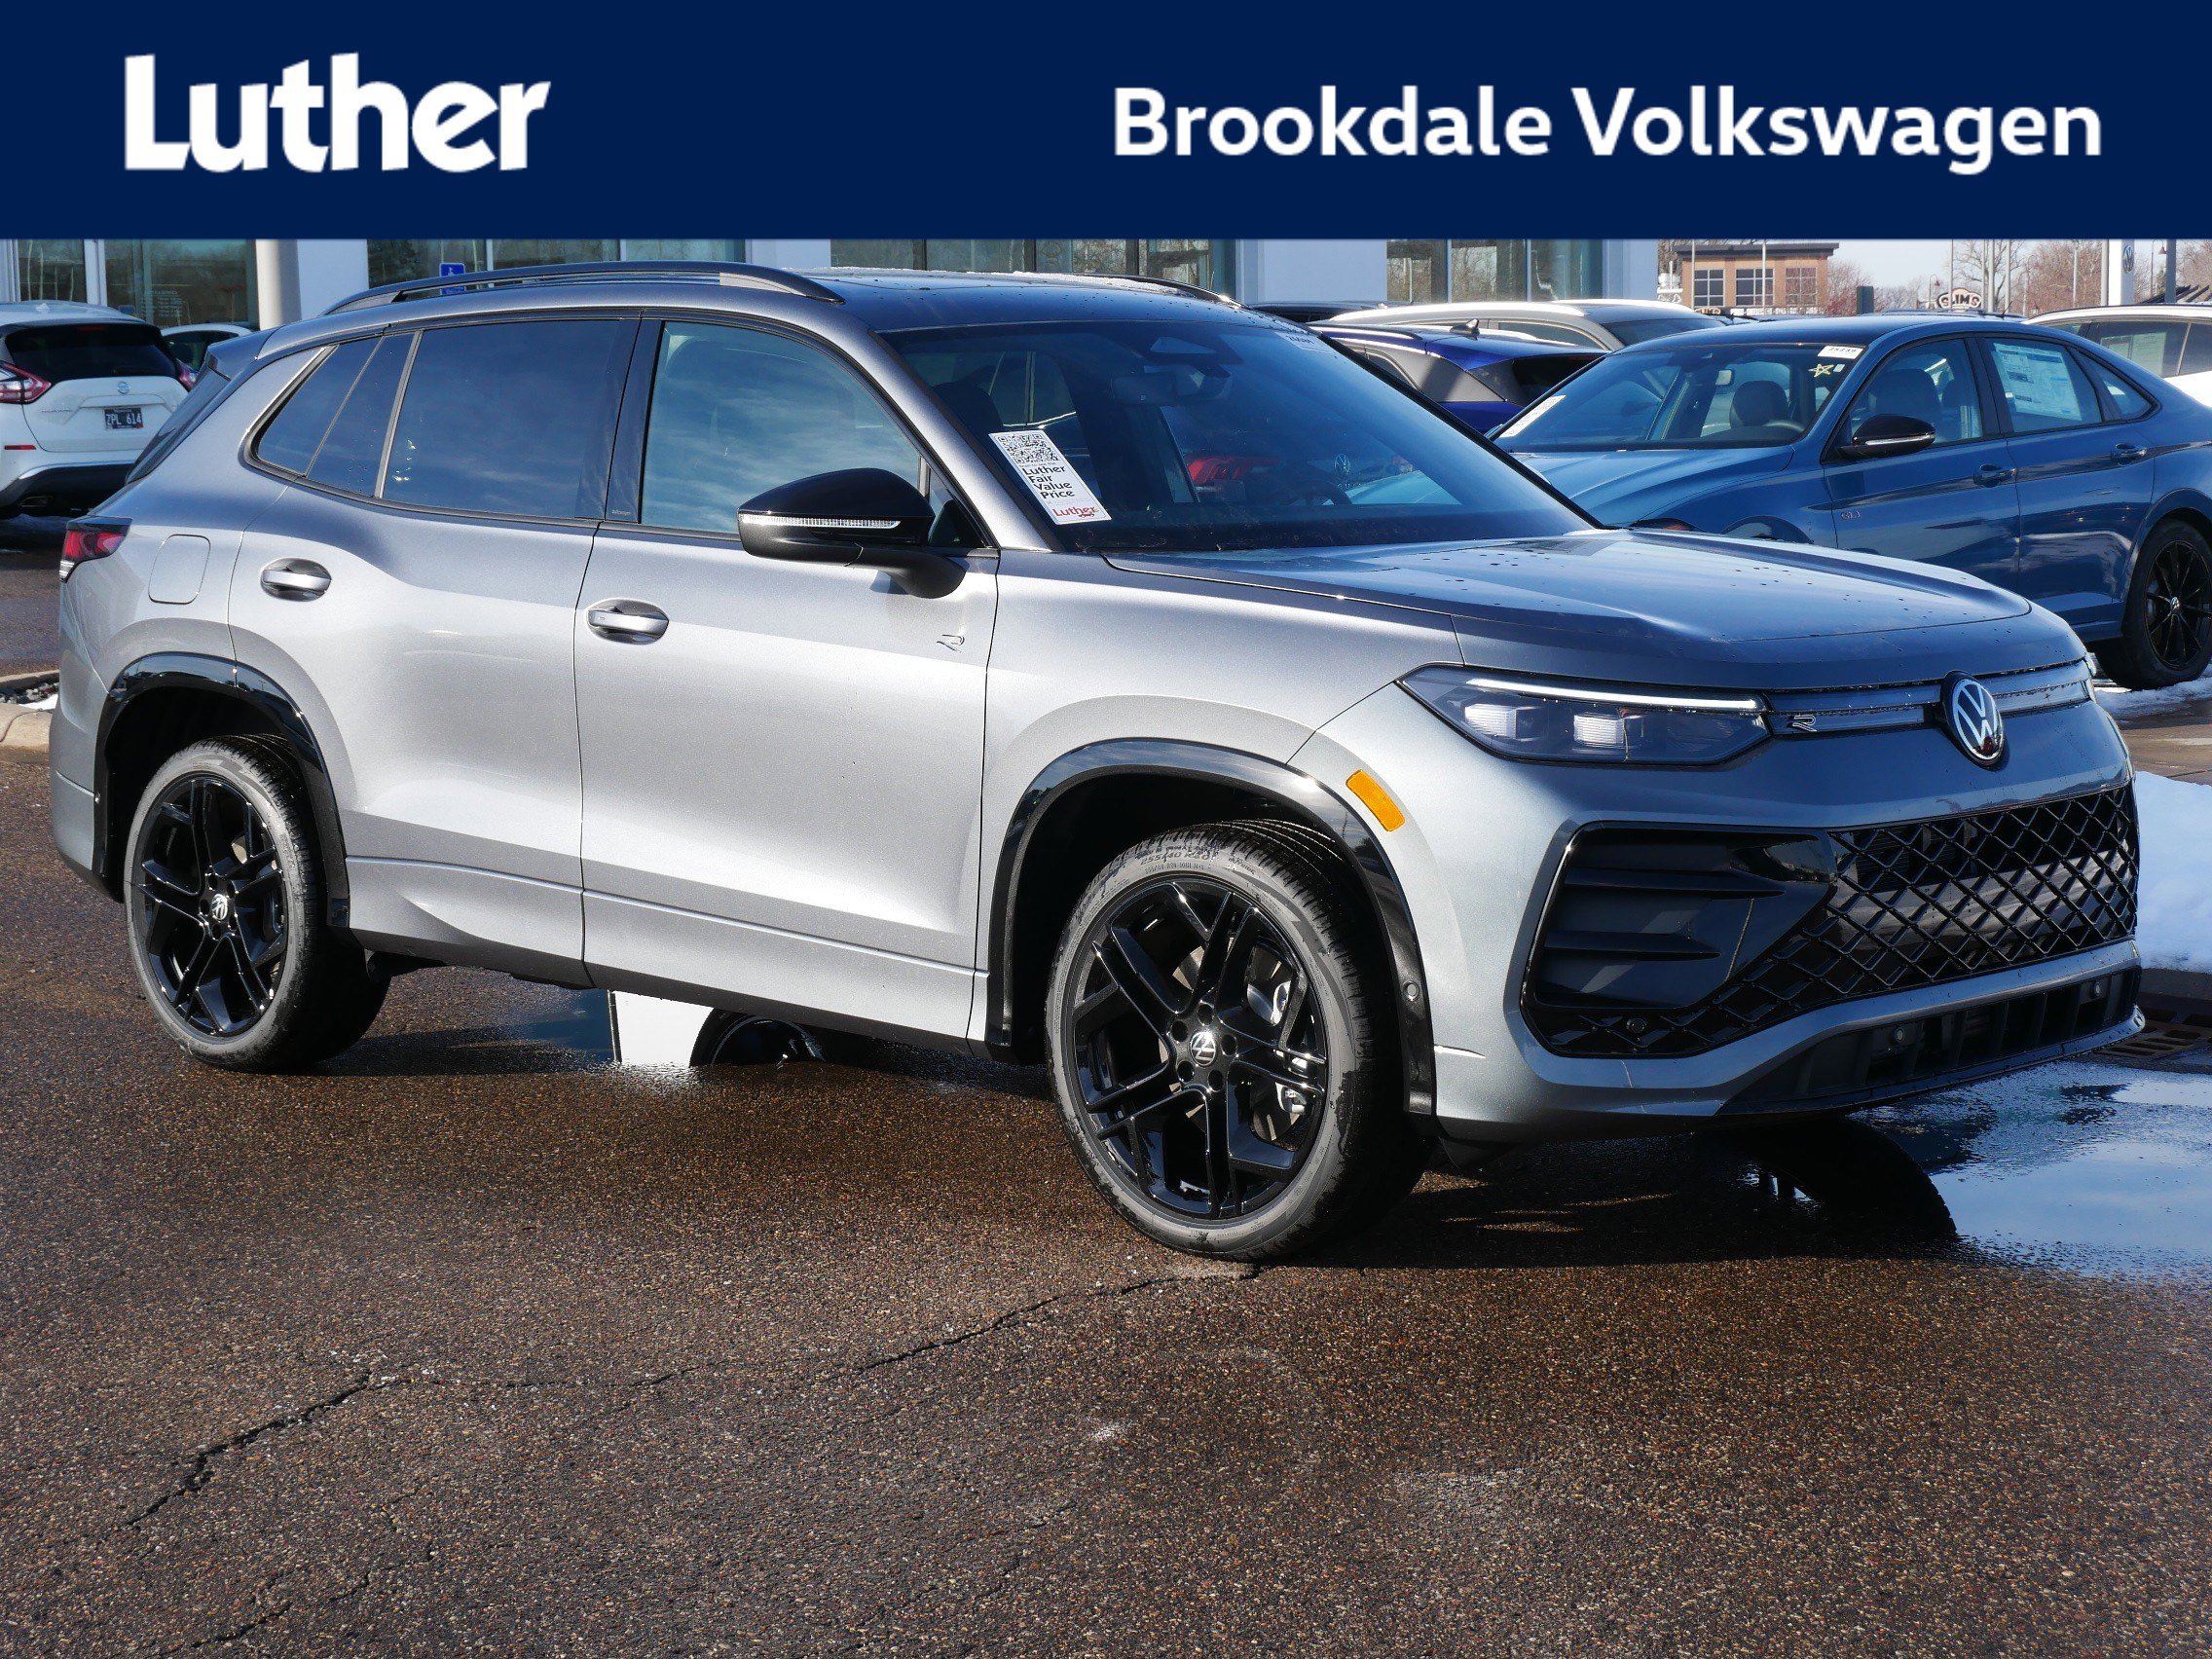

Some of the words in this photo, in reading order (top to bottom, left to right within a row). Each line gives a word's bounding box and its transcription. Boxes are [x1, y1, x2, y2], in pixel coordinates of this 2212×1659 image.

[105, 413, 122, 425] ZPL
[127, 413, 142, 424] 614
[1022, 466, 1065, 475] Luther
[1028, 473, 1053, 483] Fair
[1033, 482, 1073, 491] Value
[1041, 490, 1075, 499] Price
[1052, 507, 1096, 516] Luther
